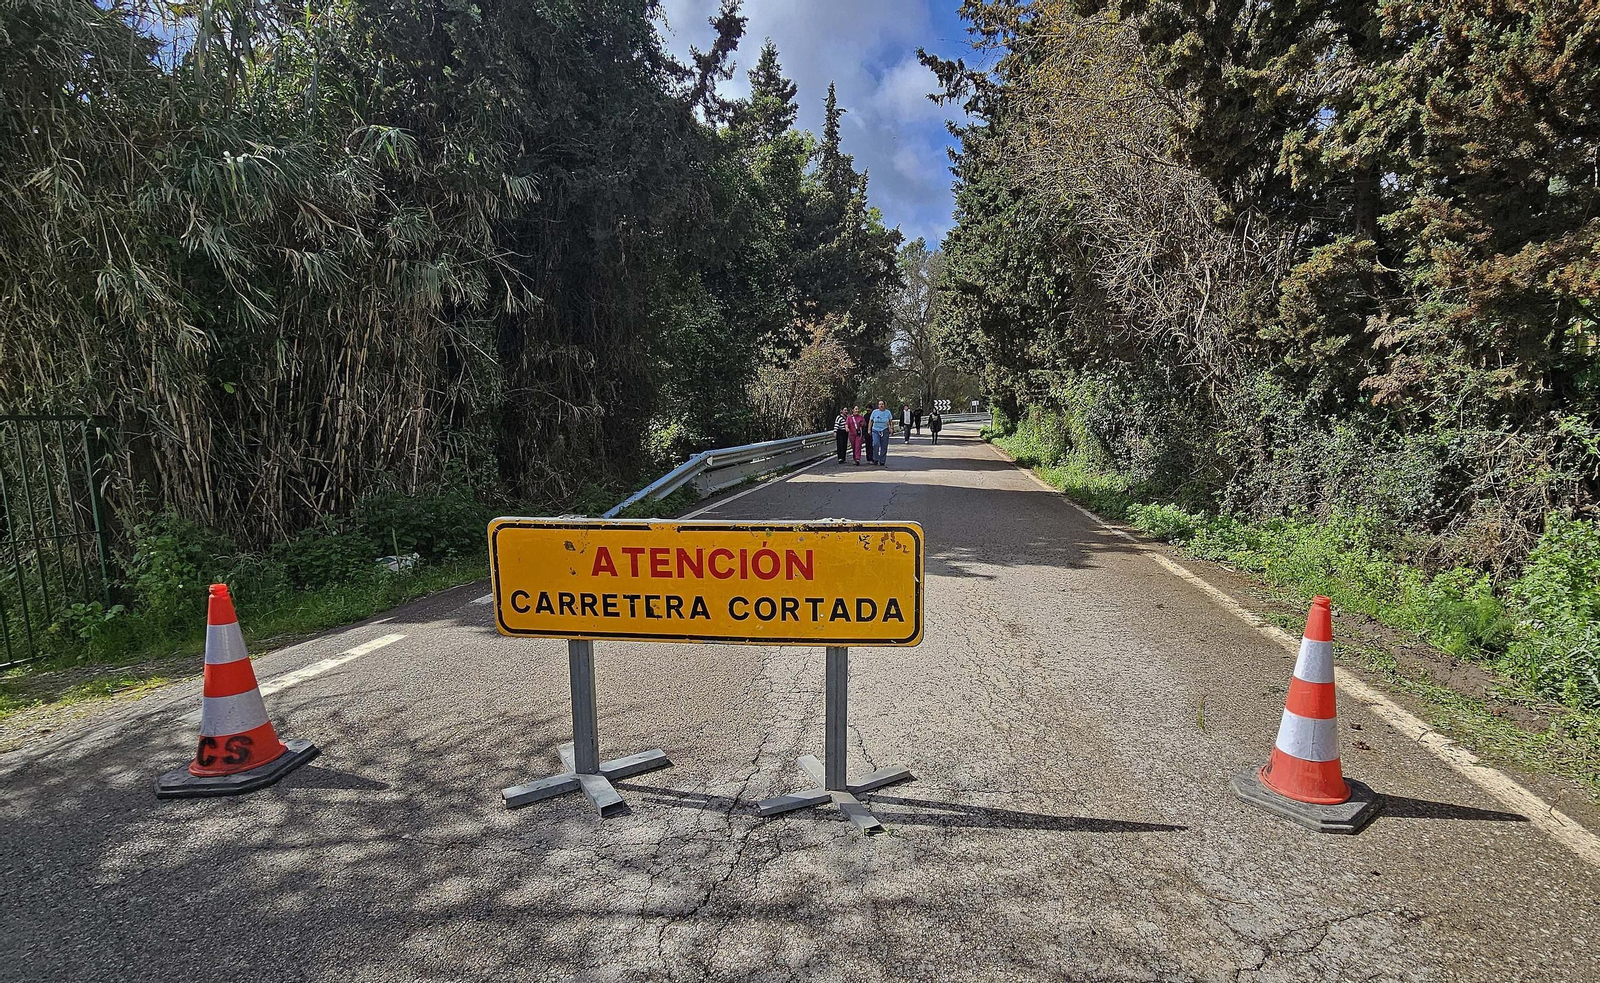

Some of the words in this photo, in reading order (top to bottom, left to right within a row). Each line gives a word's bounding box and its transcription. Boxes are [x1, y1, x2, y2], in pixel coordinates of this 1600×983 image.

[591, 541, 815, 581] ATENCIÓN
[511, 589, 711, 621] CARRETERA
[728, 596, 905, 623] CORTADA
[197, 736, 253, 765] CS
